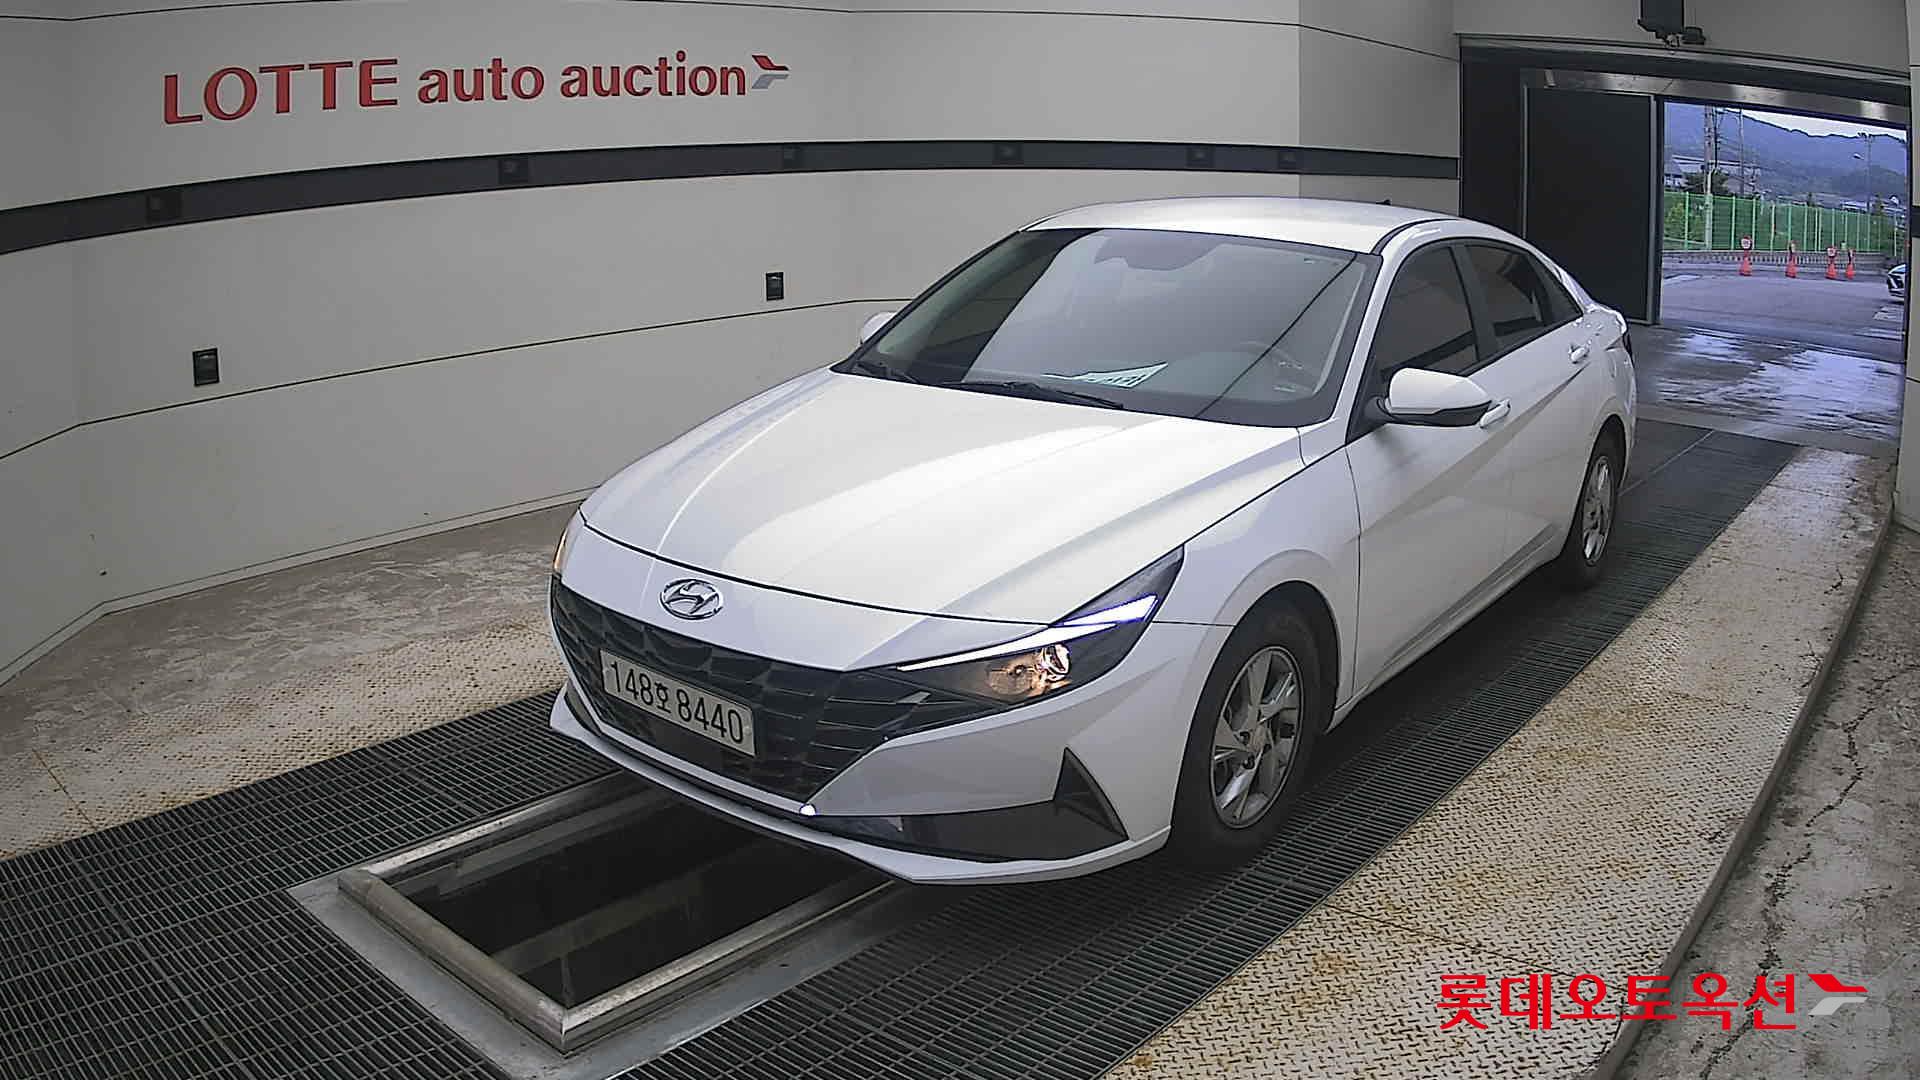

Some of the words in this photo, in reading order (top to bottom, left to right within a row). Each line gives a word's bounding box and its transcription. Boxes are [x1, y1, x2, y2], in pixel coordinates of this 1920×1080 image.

[163, 59, 398, 125] LOTTE
[417, 57, 545, 104] auto
[560, 50, 747, 98] auction
[675, 688, 744, 744] 8440
